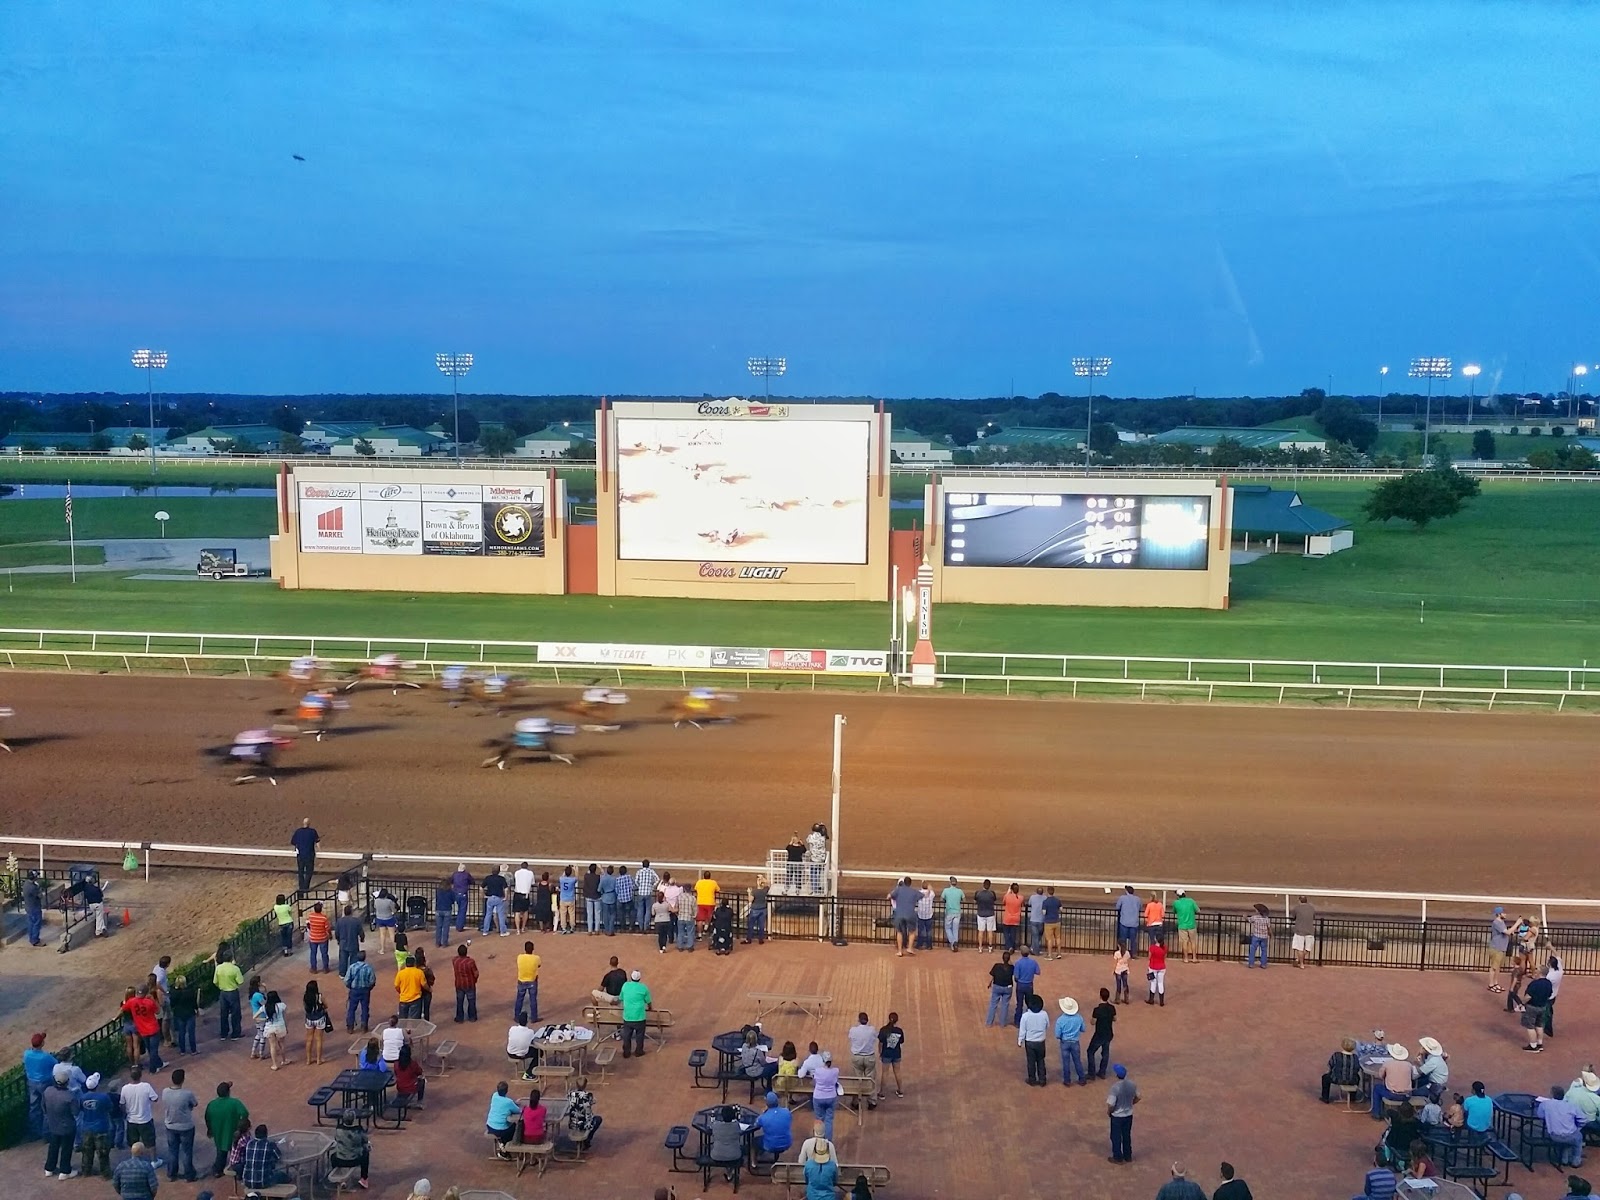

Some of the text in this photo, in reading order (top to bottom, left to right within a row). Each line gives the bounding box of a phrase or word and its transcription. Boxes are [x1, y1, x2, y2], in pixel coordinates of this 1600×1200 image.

[697, 402, 730, 415] Coors
[329, 490, 356, 498] LIGHT
[489, 487, 521, 495] Midwest
[425, 521, 480, 530] Brown & Brown
[431, 531, 474, 540] of Oklahoma
[699, 562, 788, 579] Coors LIGHT
[555, 646, 577, 657] XX
[613, 650, 647, 659] TECATE
[668, 649, 687, 660] PK
[850, 657, 883, 666] TVG
[563, 882, 570, 891] 5
